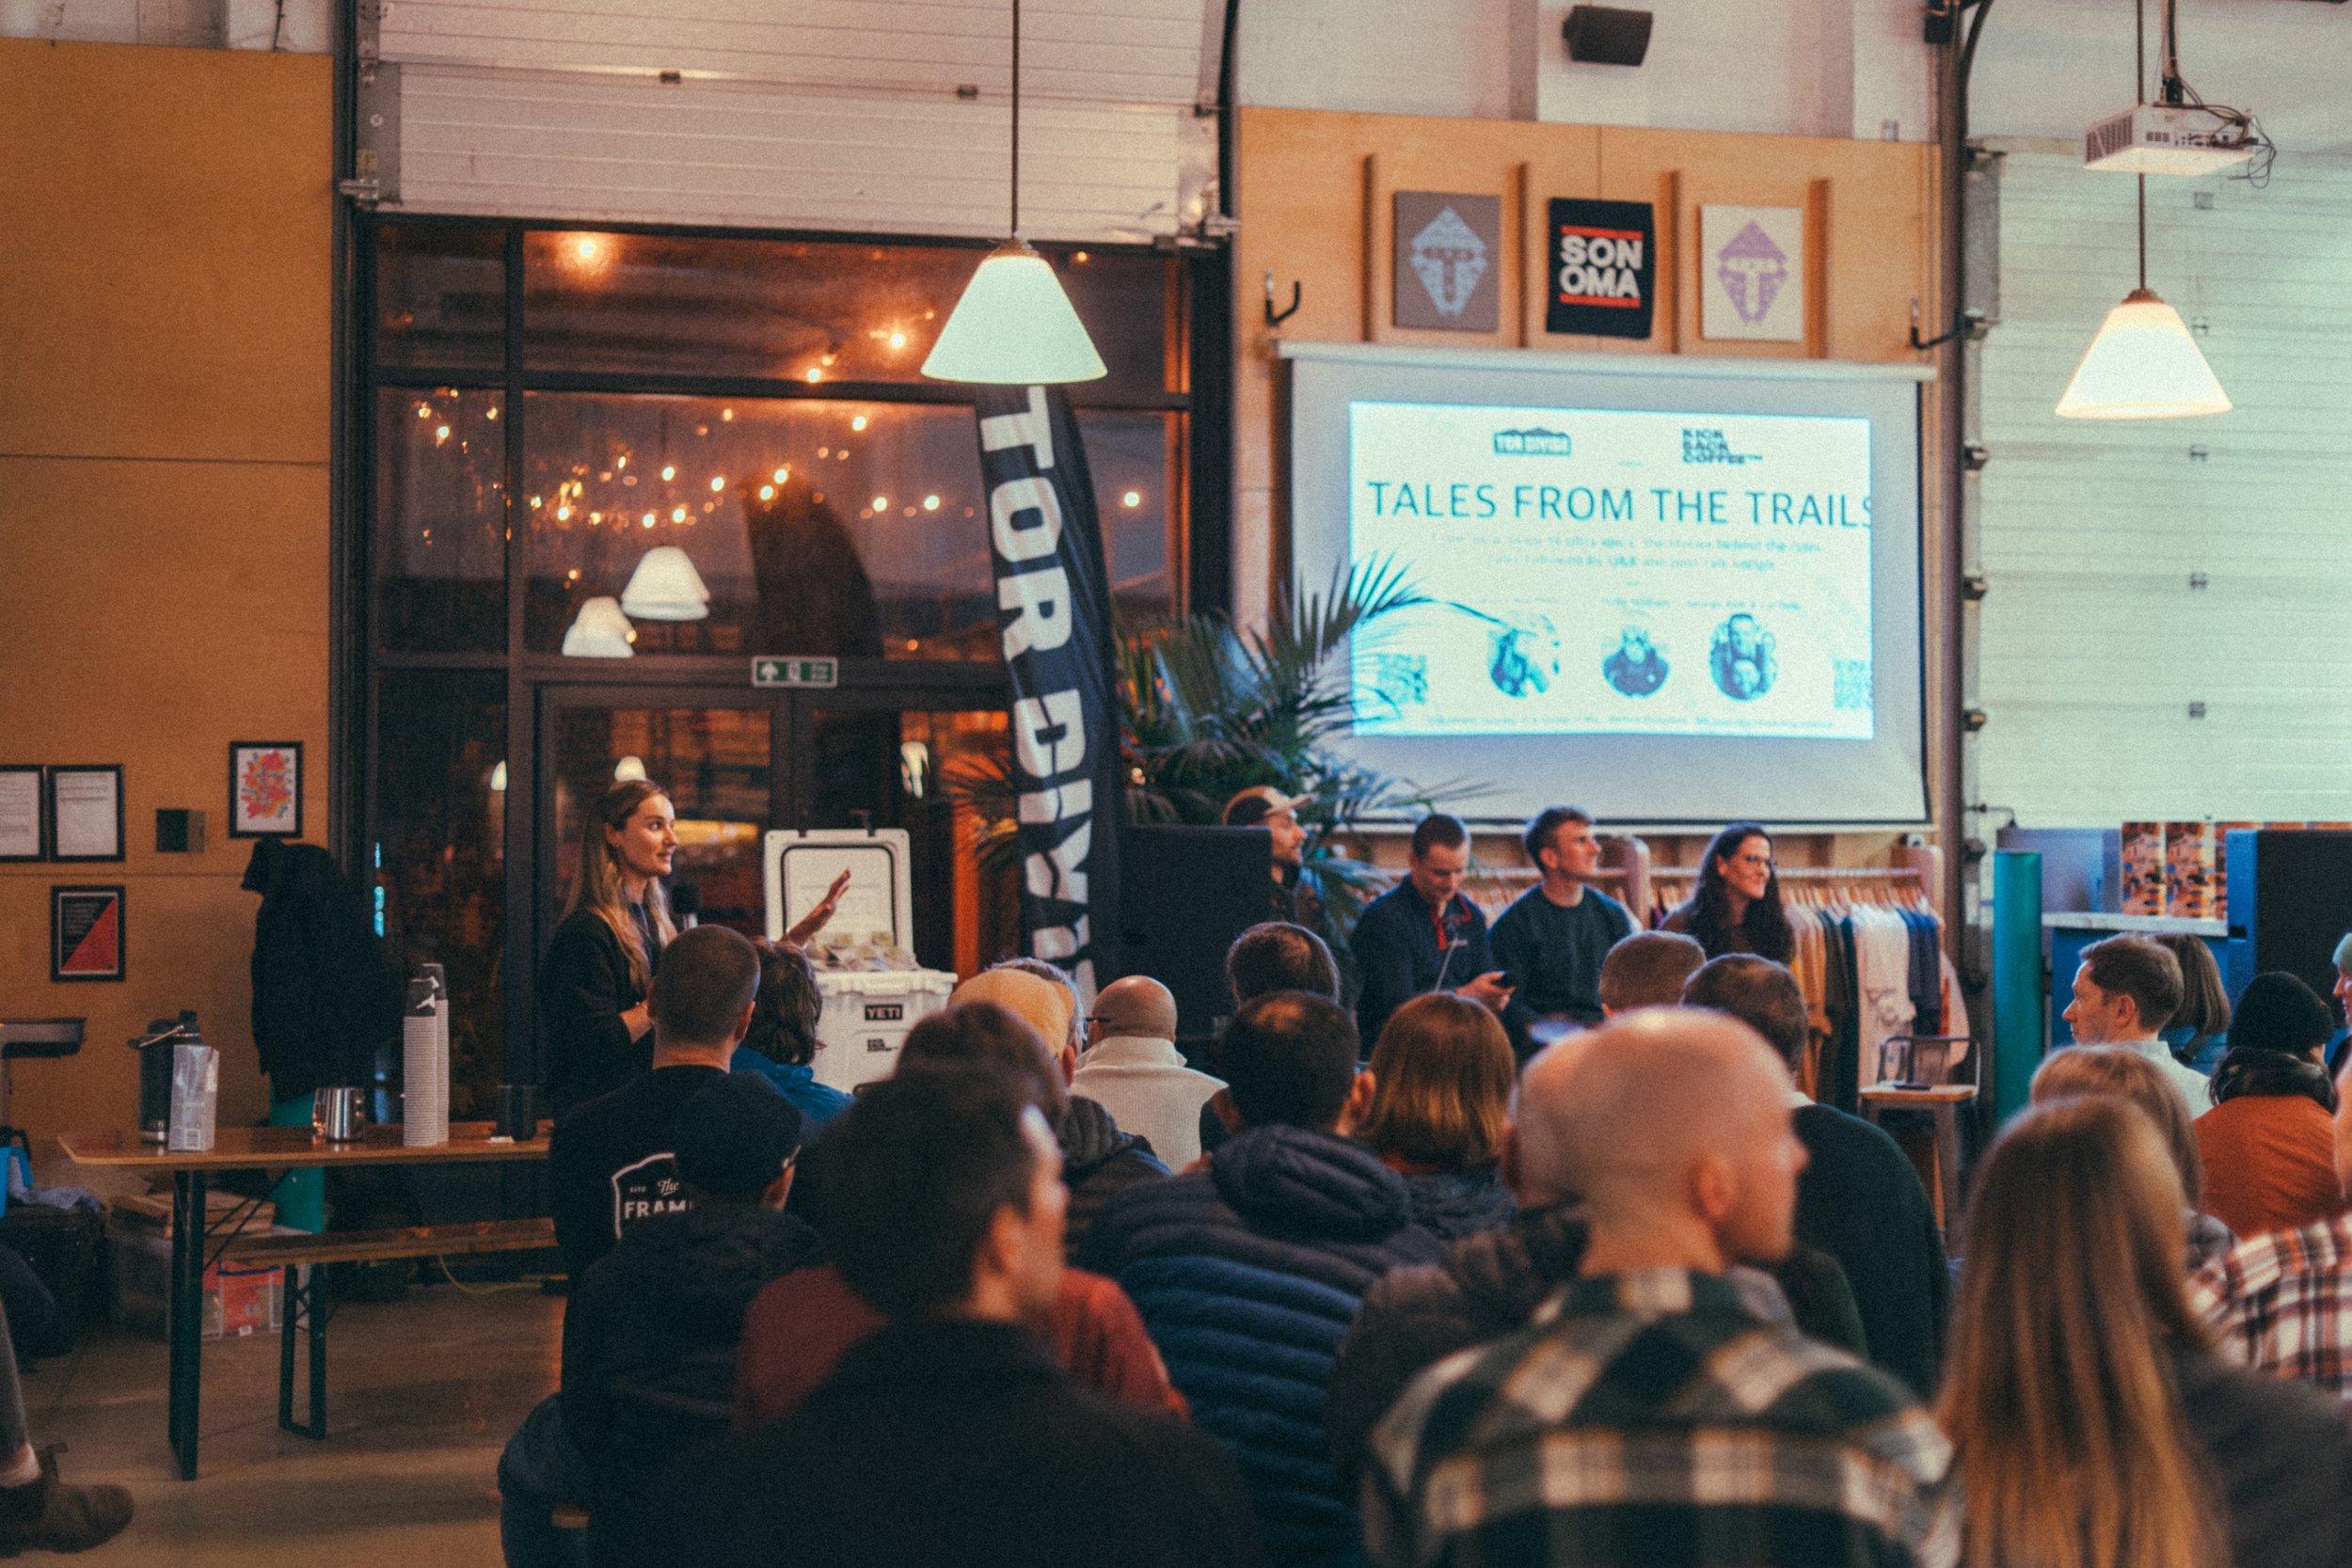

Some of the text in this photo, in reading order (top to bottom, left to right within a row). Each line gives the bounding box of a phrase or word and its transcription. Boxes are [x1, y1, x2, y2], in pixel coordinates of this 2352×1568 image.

[1560, 234, 1644, 270] SON
[1559, 264, 1641, 299] OMA
[1367, 481, 1497, 518] TALES
[1514, 484, 1634, 522] FROM
[1649, 488, 1729, 525] THE
[980, 386, 1073, 661] TOR
[866, 1006, 900, 1020] YETI
[658, 1178, 679, 1196] The
[624, 1199, 692, 1219] FRAM
